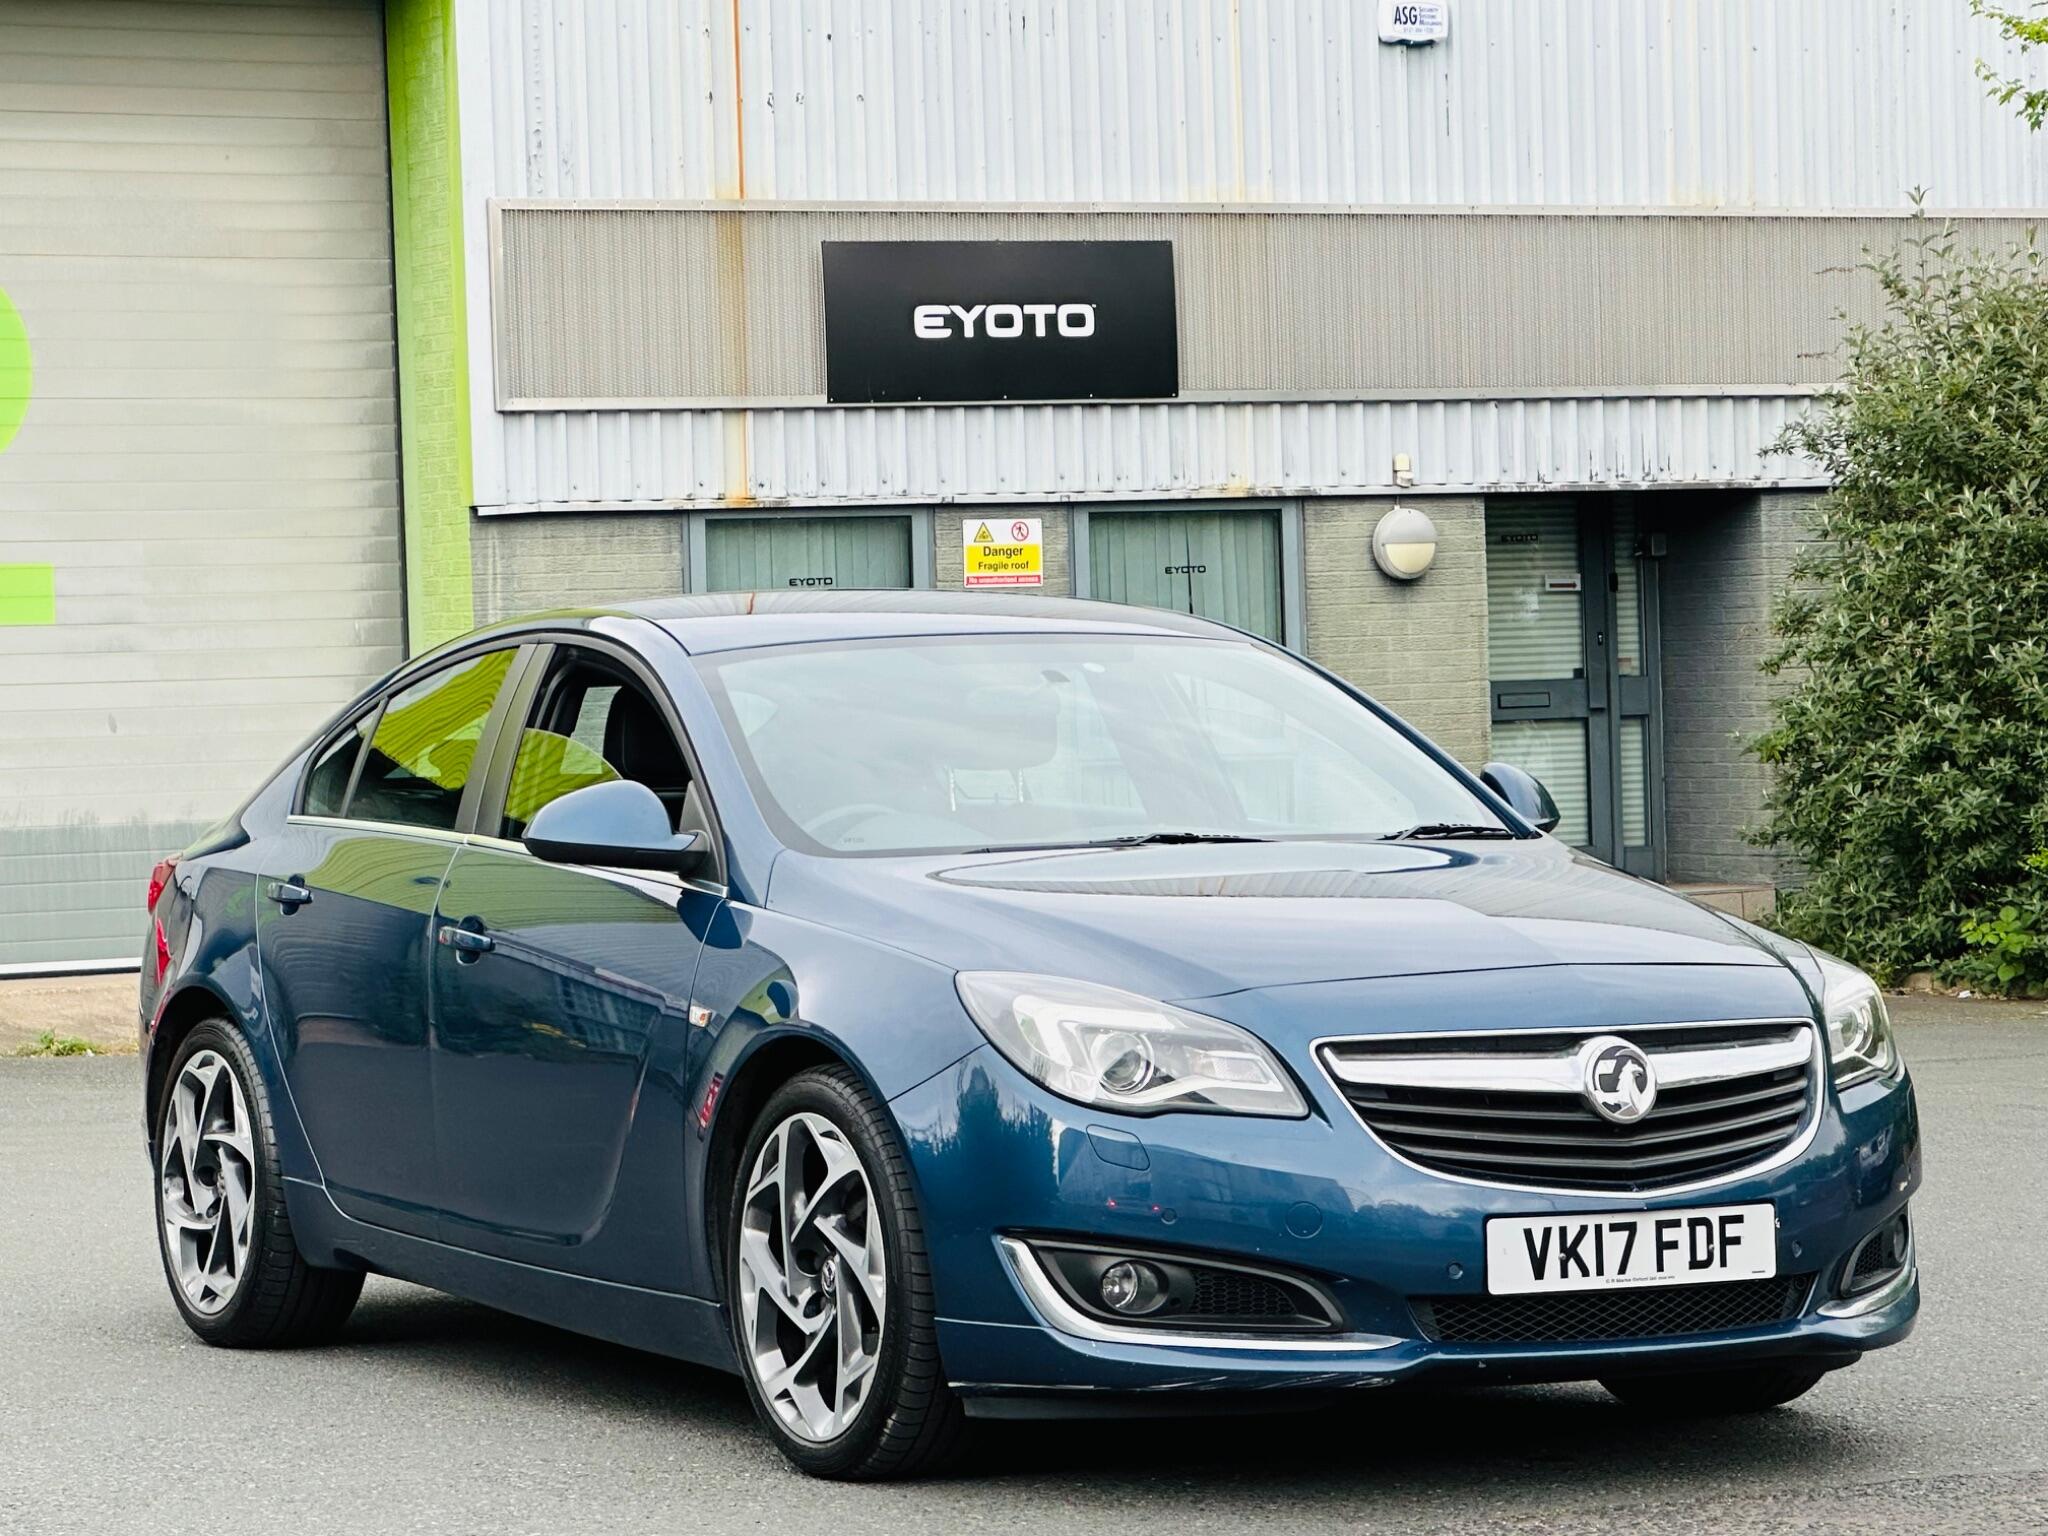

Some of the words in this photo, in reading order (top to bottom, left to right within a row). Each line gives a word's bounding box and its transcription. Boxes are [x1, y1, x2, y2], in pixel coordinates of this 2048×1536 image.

[1394, 6, 1418, 25] ASG
[914, 304, 1095, 339] EYOTO
[983, 546, 1023, 558] Danger
[978, 562, 1009, 572] Fragile
[1011, 561, 1029, 570] roof
[1164, 566, 1206, 574] EYOTO
[789, 577, 832, 586] EYOTO
[1522, 1221, 1638, 1281] VK17
[1655, 1214, 1744, 1273] FDF
